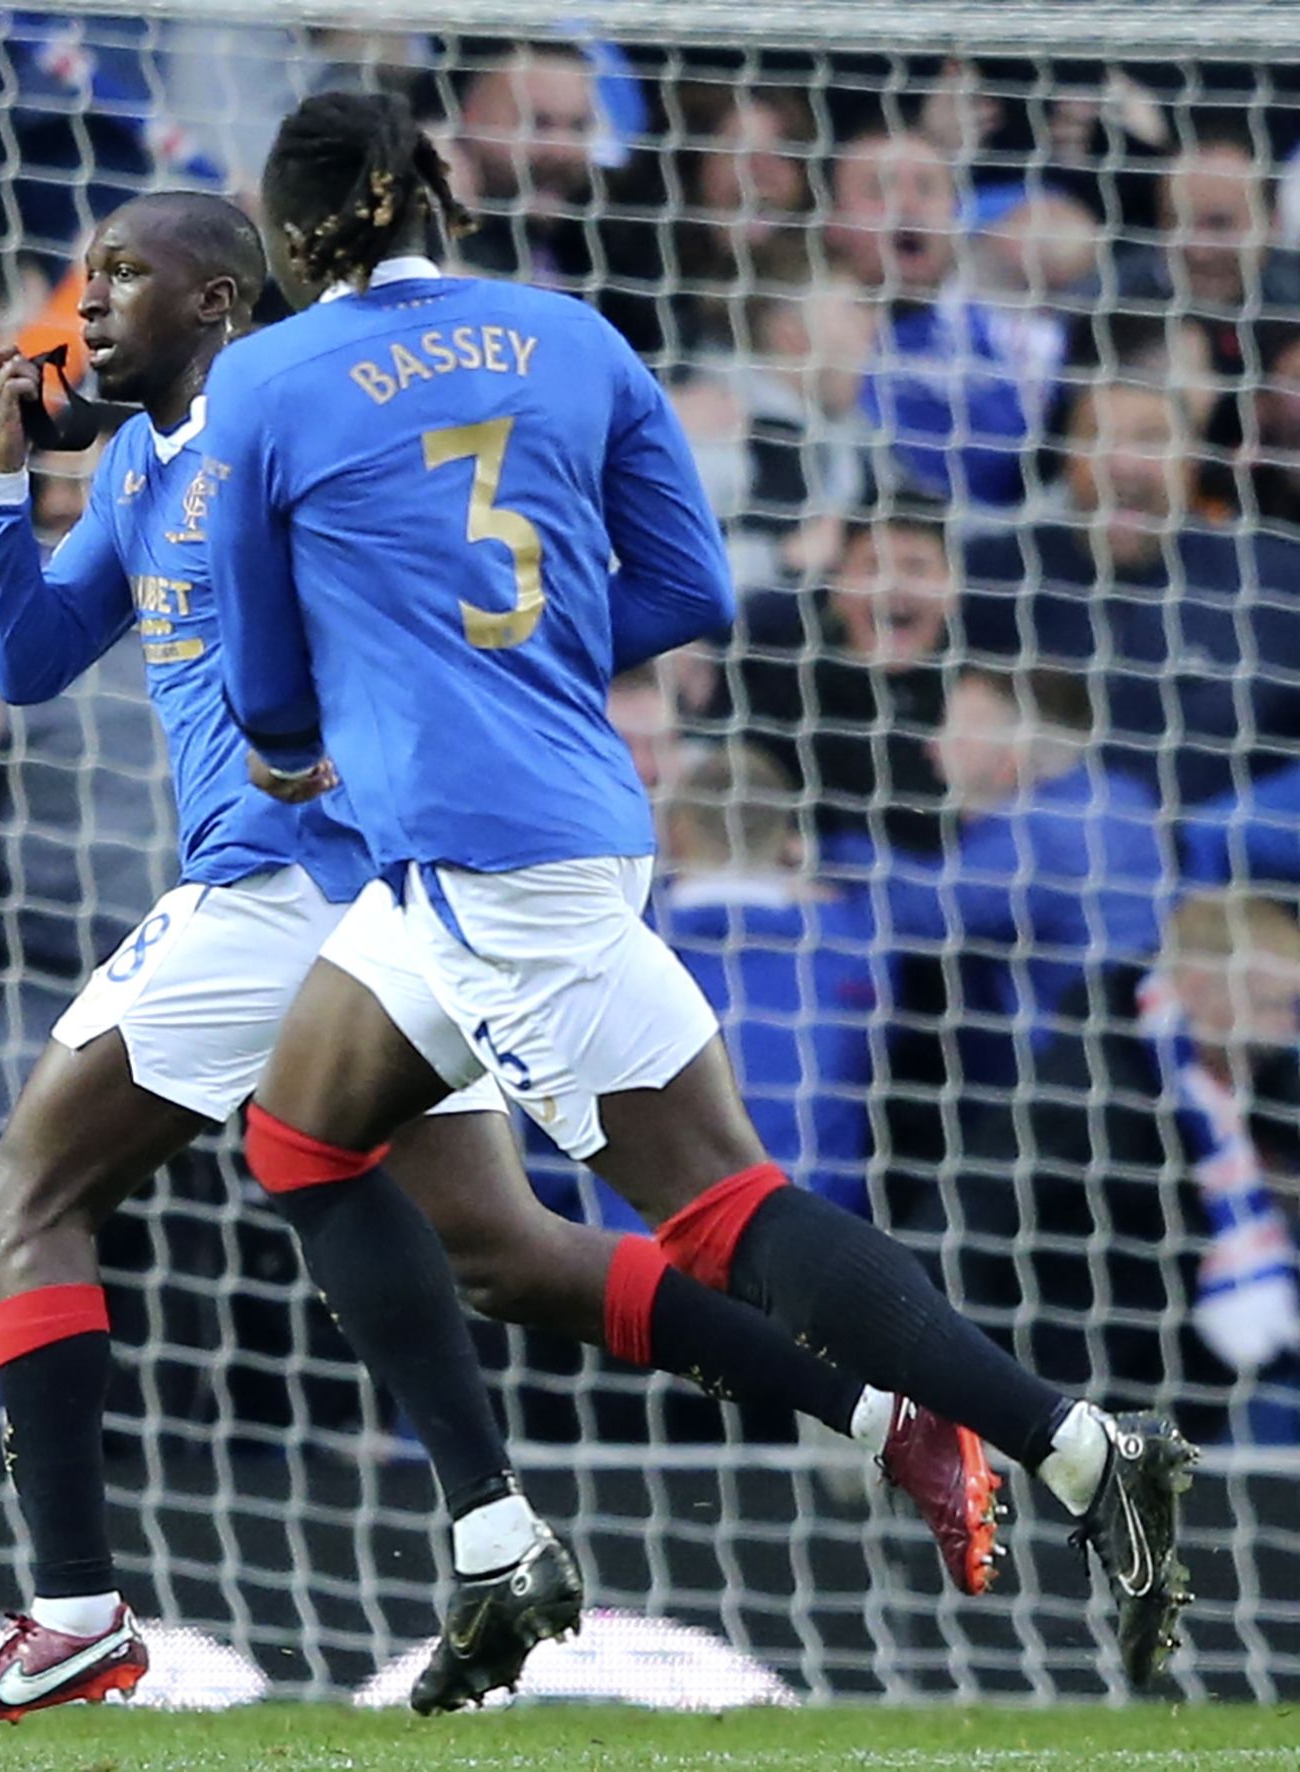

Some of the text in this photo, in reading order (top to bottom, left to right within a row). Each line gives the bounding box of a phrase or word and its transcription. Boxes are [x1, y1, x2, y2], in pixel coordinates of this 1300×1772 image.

[349, 325, 538, 405] BASSEY
[421, 416, 545, 649] 3
[106, 912, 171, 982] 8
